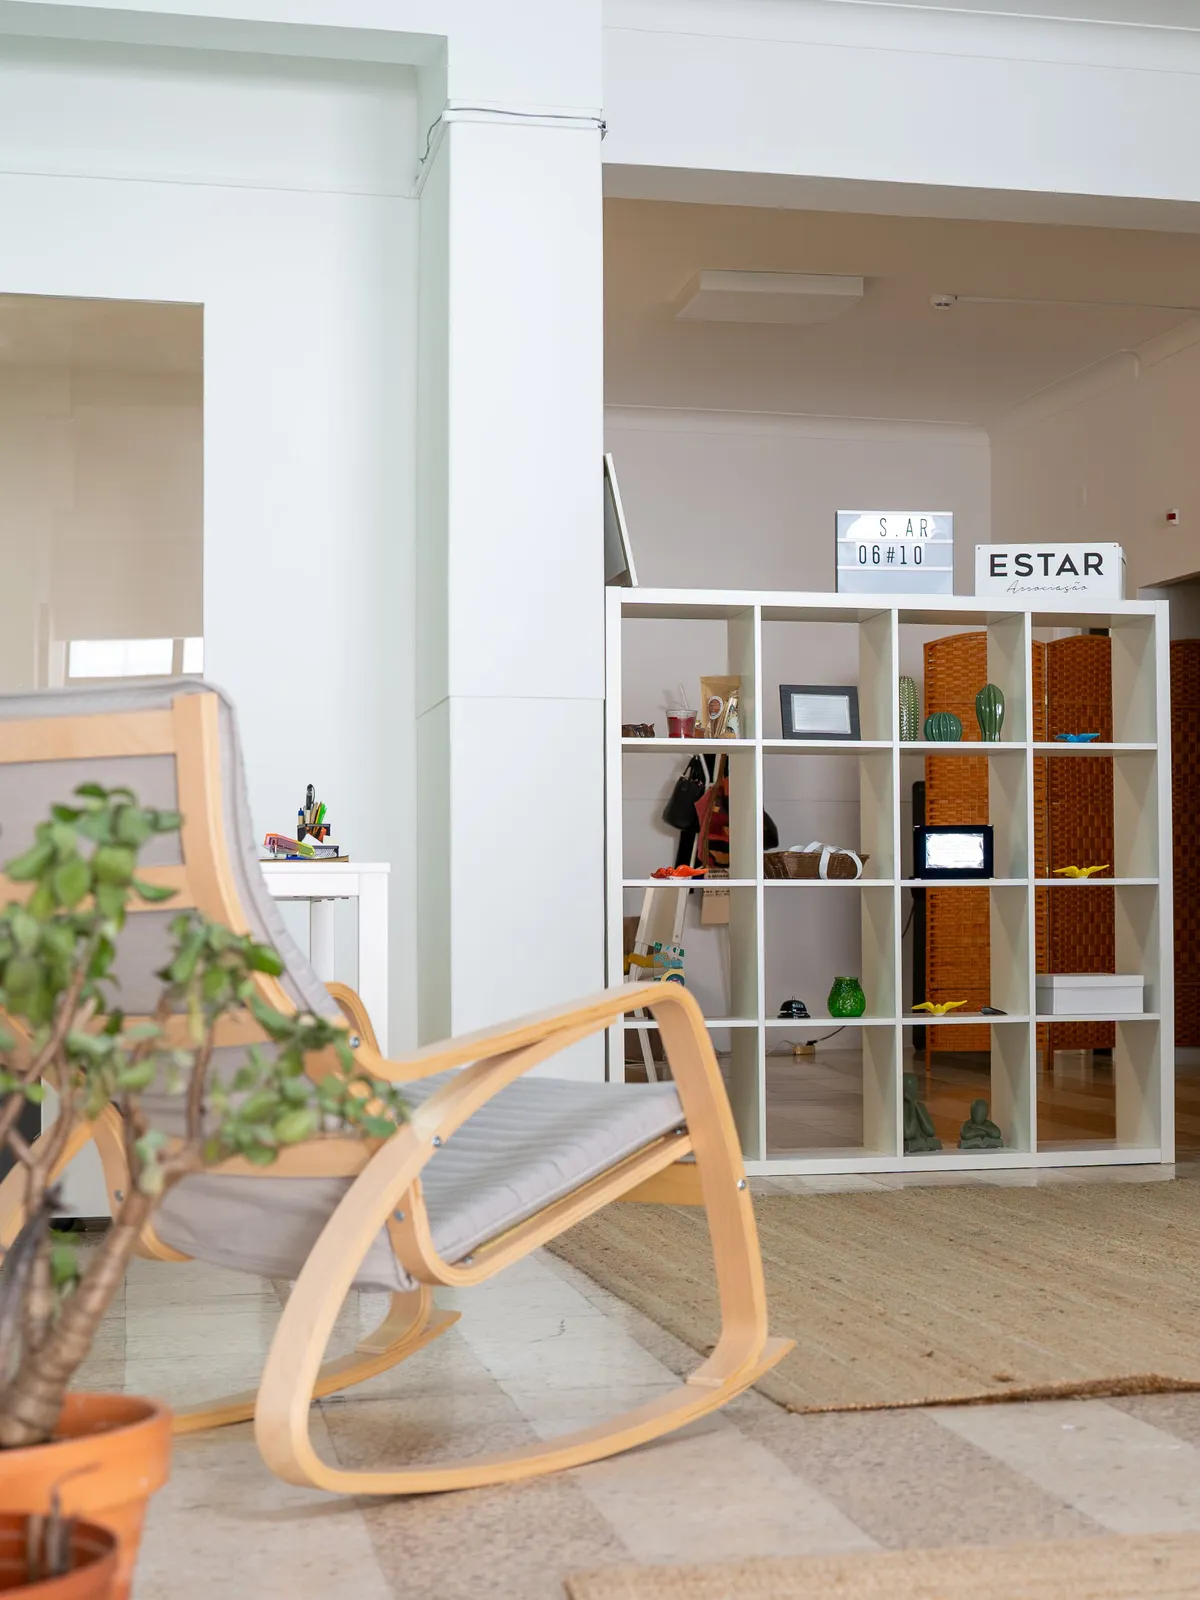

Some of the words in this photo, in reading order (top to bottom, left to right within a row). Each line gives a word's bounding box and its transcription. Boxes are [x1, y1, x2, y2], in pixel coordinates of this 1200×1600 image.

[858, 544, 923, 565] 06#10
[989, 552, 1104, 577] ESTAR
[1006, 580, 1089, 594] Associação
